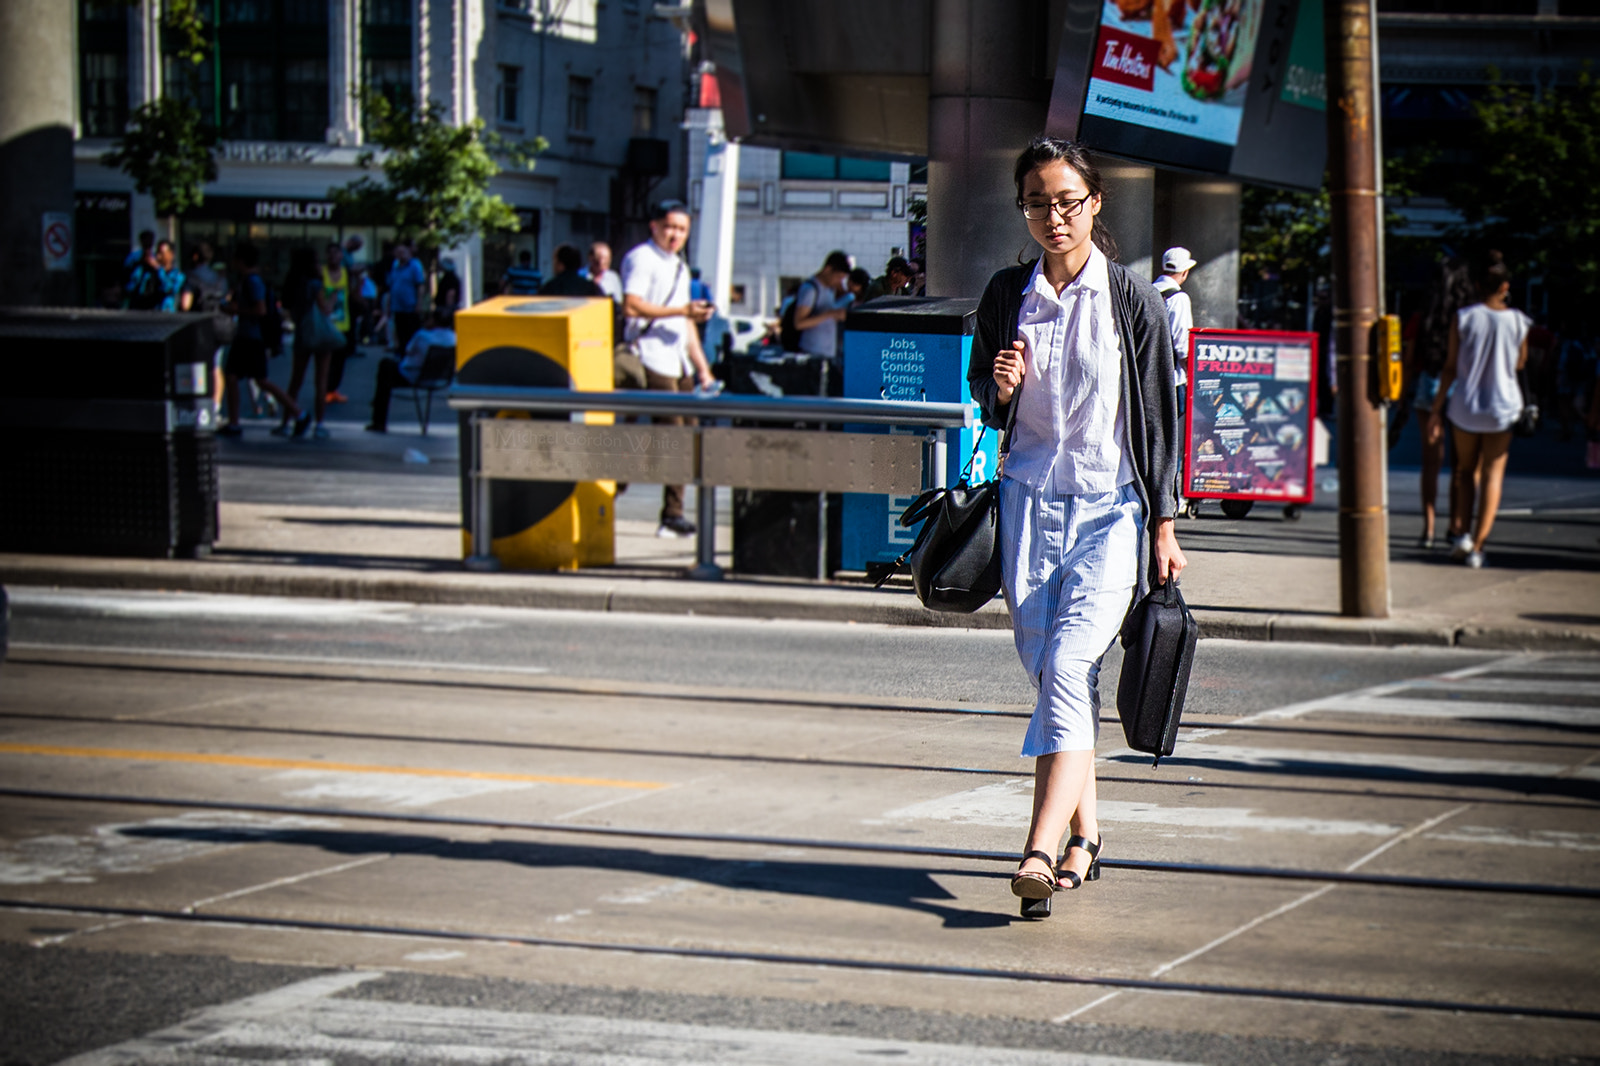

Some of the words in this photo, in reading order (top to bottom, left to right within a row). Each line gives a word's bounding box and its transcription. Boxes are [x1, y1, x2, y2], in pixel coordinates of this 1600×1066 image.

[256, 201, 336, 220] INGLOT
[890, 337, 917, 350] Jobs
[881, 348, 925, 362] Rentals
[1197, 344, 1274, 363] INDIE
[881, 360, 925, 373] Condos
[1197, 361, 1273, 374] FRIDAYS
[882, 372, 923, 385] Homes
[889, 384, 917, 396] Cars
